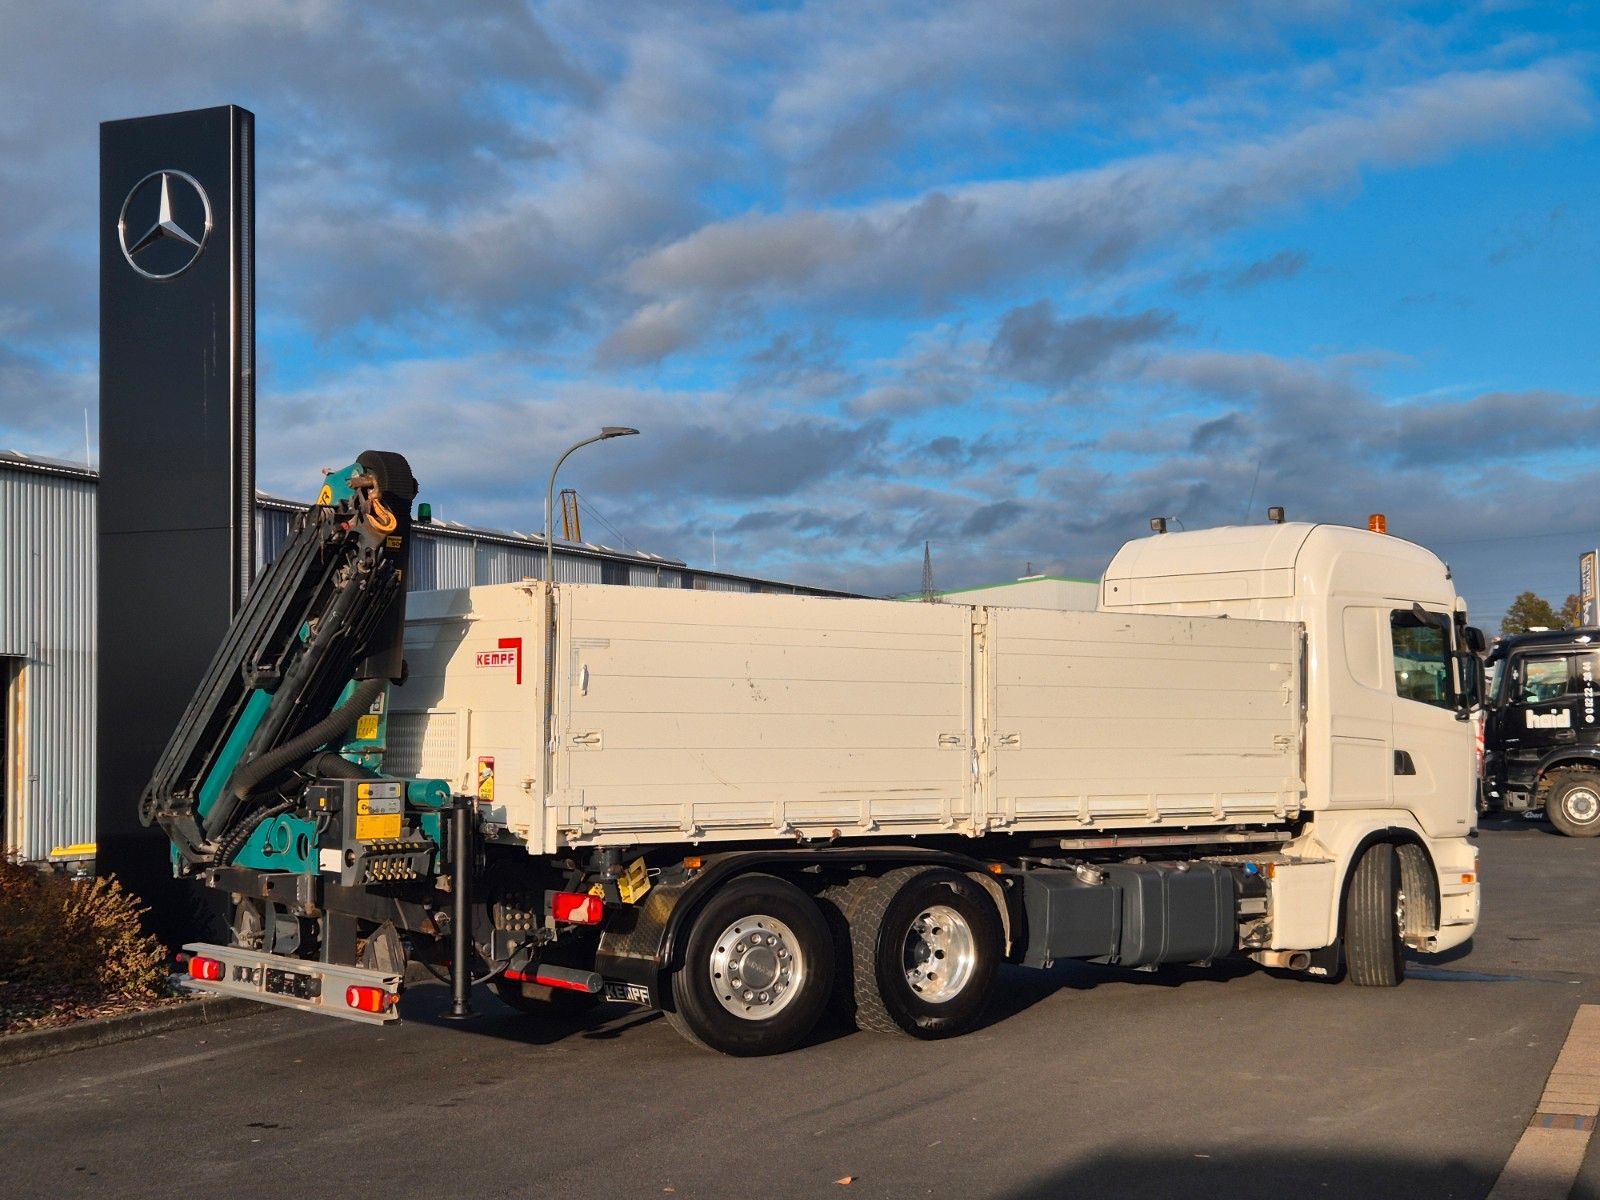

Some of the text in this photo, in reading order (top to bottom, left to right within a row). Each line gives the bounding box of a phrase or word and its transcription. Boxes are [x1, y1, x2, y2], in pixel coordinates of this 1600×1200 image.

[477, 653, 515, 666] KEMPF
[1526, 708, 1570, 728] haid
[605, 983, 649, 1003] KEMPF
